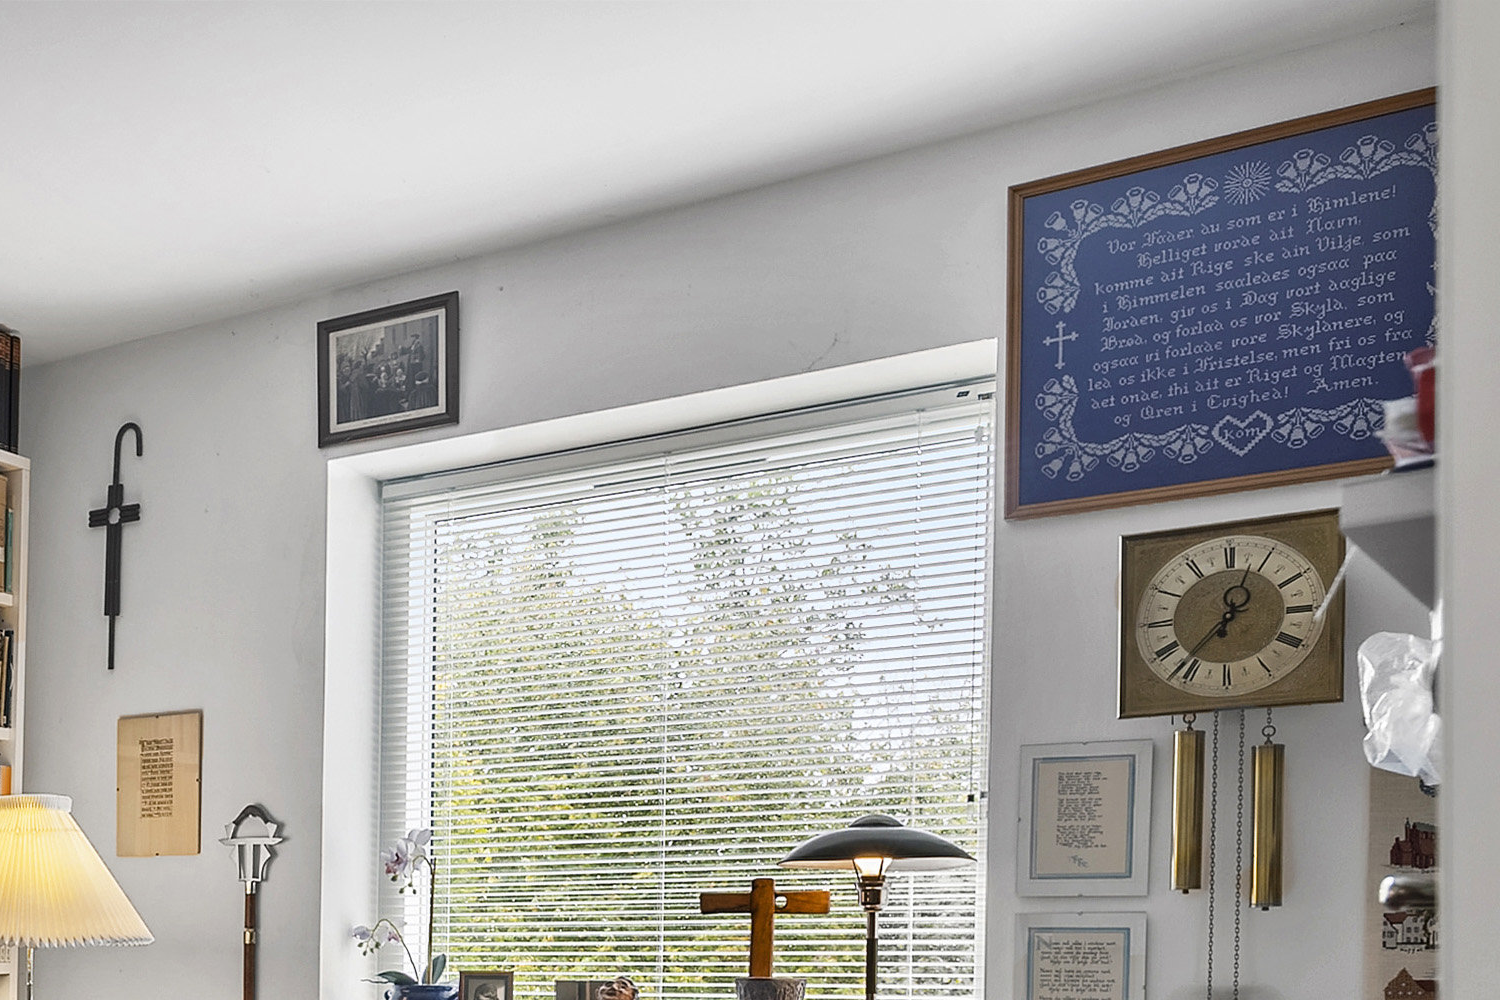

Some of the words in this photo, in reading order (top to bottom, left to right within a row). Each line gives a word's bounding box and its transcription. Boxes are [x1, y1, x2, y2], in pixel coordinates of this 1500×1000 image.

[1106, 238, 1136, 254] Vor
[1200, 223, 1220, 235] du
[1226, 214, 1262, 230] som
[1267, 209, 1285, 222] er
[1291, 203, 1298, 217] i
[1306, 184, 1396, 214] Himlene!
[1136, 242, 1207, 269] Helliget
[1214, 234, 1260, 252] vorde
[1268, 225, 1294, 242] dit
[1094, 275, 1154, 295] komme
[1160, 267, 1184, 283] dit
[1243, 250, 1274, 267] ske
[1281, 244, 1310, 259] din
[1372, 224, 1411, 243] som
[1102, 301, 1108, 313] i
[1115, 284, 1206, 312] Himmelen
[1215, 269, 1290, 292] saaledes
[1297, 258, 1349, 279] ogsaa
[1362, 249, 1397, 268] paa
[1152, 330, 1171, 344] og
[1175, 319, 1224, 338] forlad
[1229, 316, 1248, 328] os
[1254, 311, 1282, 324] vor
[1357, 286, 1395, 307] som
[1169, 305, 1195, 323] giv
[1201, 302, 1218, 314] os
[1225, 297, 1232, 310] i
[1239, 290, 1279, 308] Dag
[1285, 278, 1321, 299] vort
[1328, 268, 1396, 291] daglige
[1087, 377, 1112, 391] led
[1118, 374, 1135, 386] os
[1140, 366, 1176, 383] ikke
[1182, 362, 1189, 375] i
[1281, 339, 1321, 359] men
[1327, 336, 1352, 351] fri
[1357, 334, 1376, 346] os
[1384, 326, 1412, 342] fra
[1092, 355, 1139, 373] ogsaa
[1145, 349, 1160, 363] vi
[1164, 340, 1223, 359] forlade
[1231, 332, 1267, 348] vore
[1384, 309, 1405, 324] og
[1090, 394, 1115, 410] det
[1167, 382, 1189, 397] thi
[1194, 377, 1219, 392] dit
[1224, 376, 1242, 388] er
[1245, 364, 1297, 385] Riget
[1303, 363, 1324, 378] og
[1113, 413, 1132, 427] og
[1191, 400, 1197, 412] i
[1306, 376, 1379, 395] Amen.
[1223, 424, 1262, 442] kom
